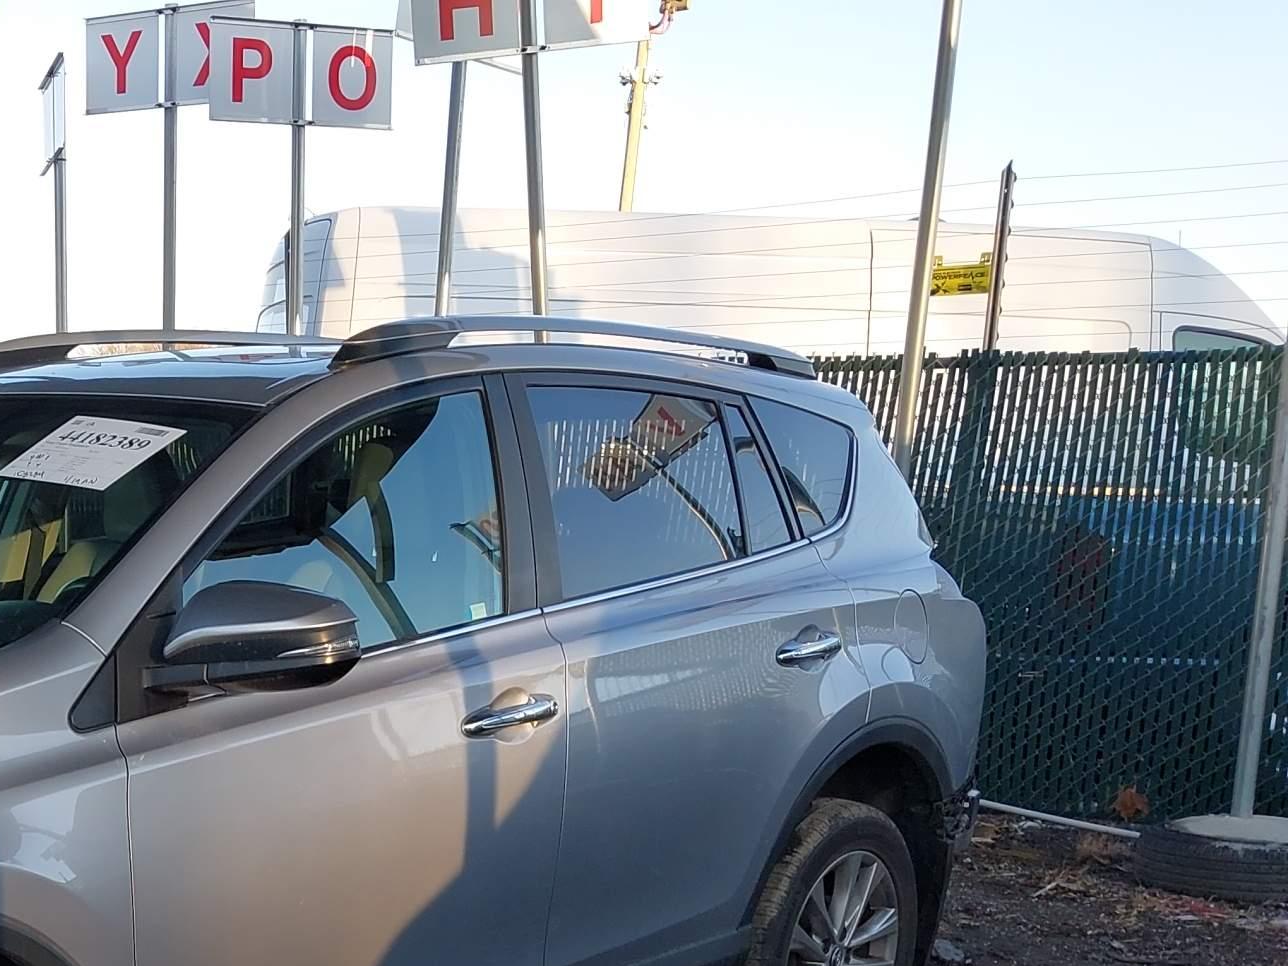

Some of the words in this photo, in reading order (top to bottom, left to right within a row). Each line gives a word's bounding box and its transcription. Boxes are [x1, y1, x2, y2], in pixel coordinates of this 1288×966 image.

[102, 30, 142, 94] Y
[231, 37, 274, 103] P
[328, 45, 377, 111] O
[58, 429, 152, 451] 44182389
